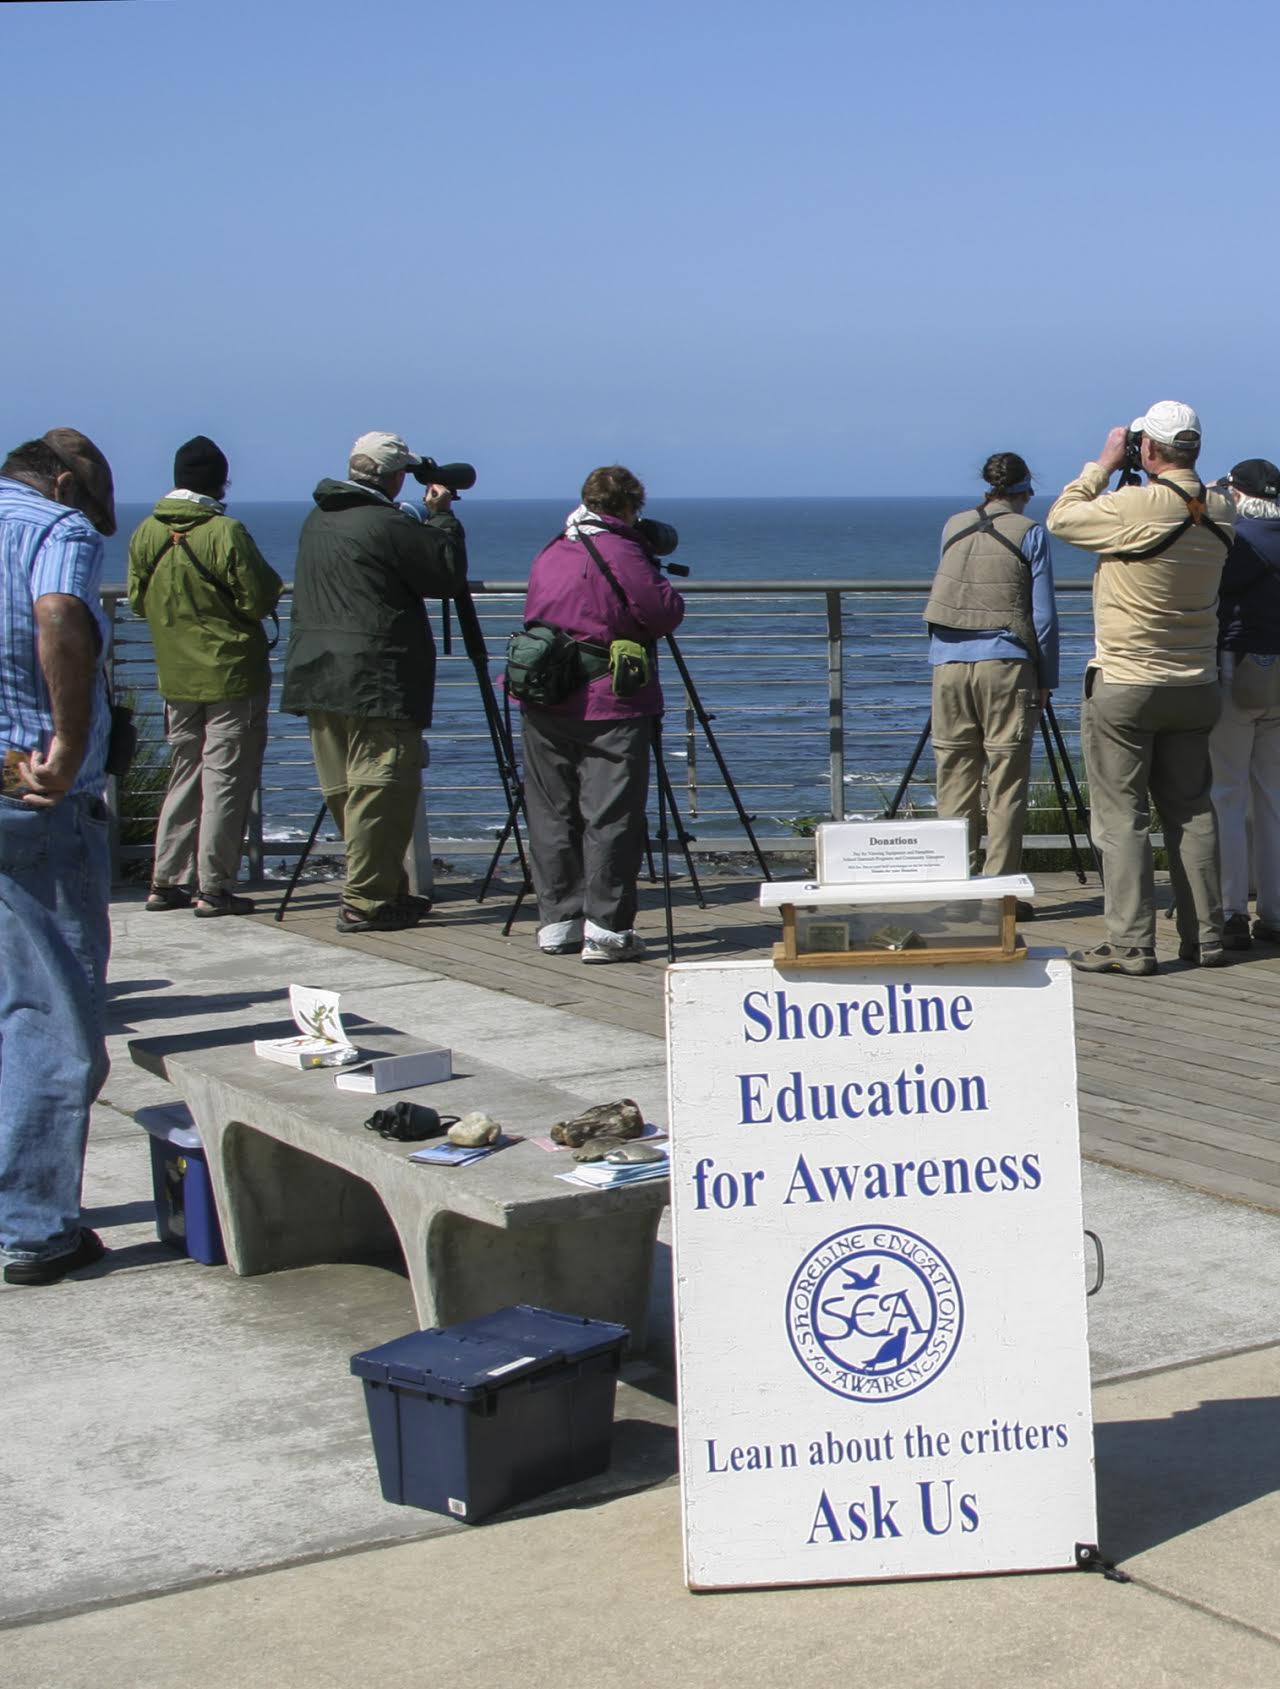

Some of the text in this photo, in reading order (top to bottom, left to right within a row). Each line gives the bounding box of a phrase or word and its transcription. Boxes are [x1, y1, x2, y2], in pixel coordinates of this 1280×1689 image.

[869, 836, 918, 846] Donations
[743, 983, 973, 1043] Shoreline
[735, 1064, 989, 1125] Education
[692, 1153, 1042, 1210] for Awareness
[873, 1233, 956, 1334] EDUCATION
[820, 1288, 931, 1341] SEA
[807, 1337, 949, 1394] for AWARENESS
[704, 1418, 1069, 1473] Learn about the critters
[807, 1480, 980, 1545] Ask Us
